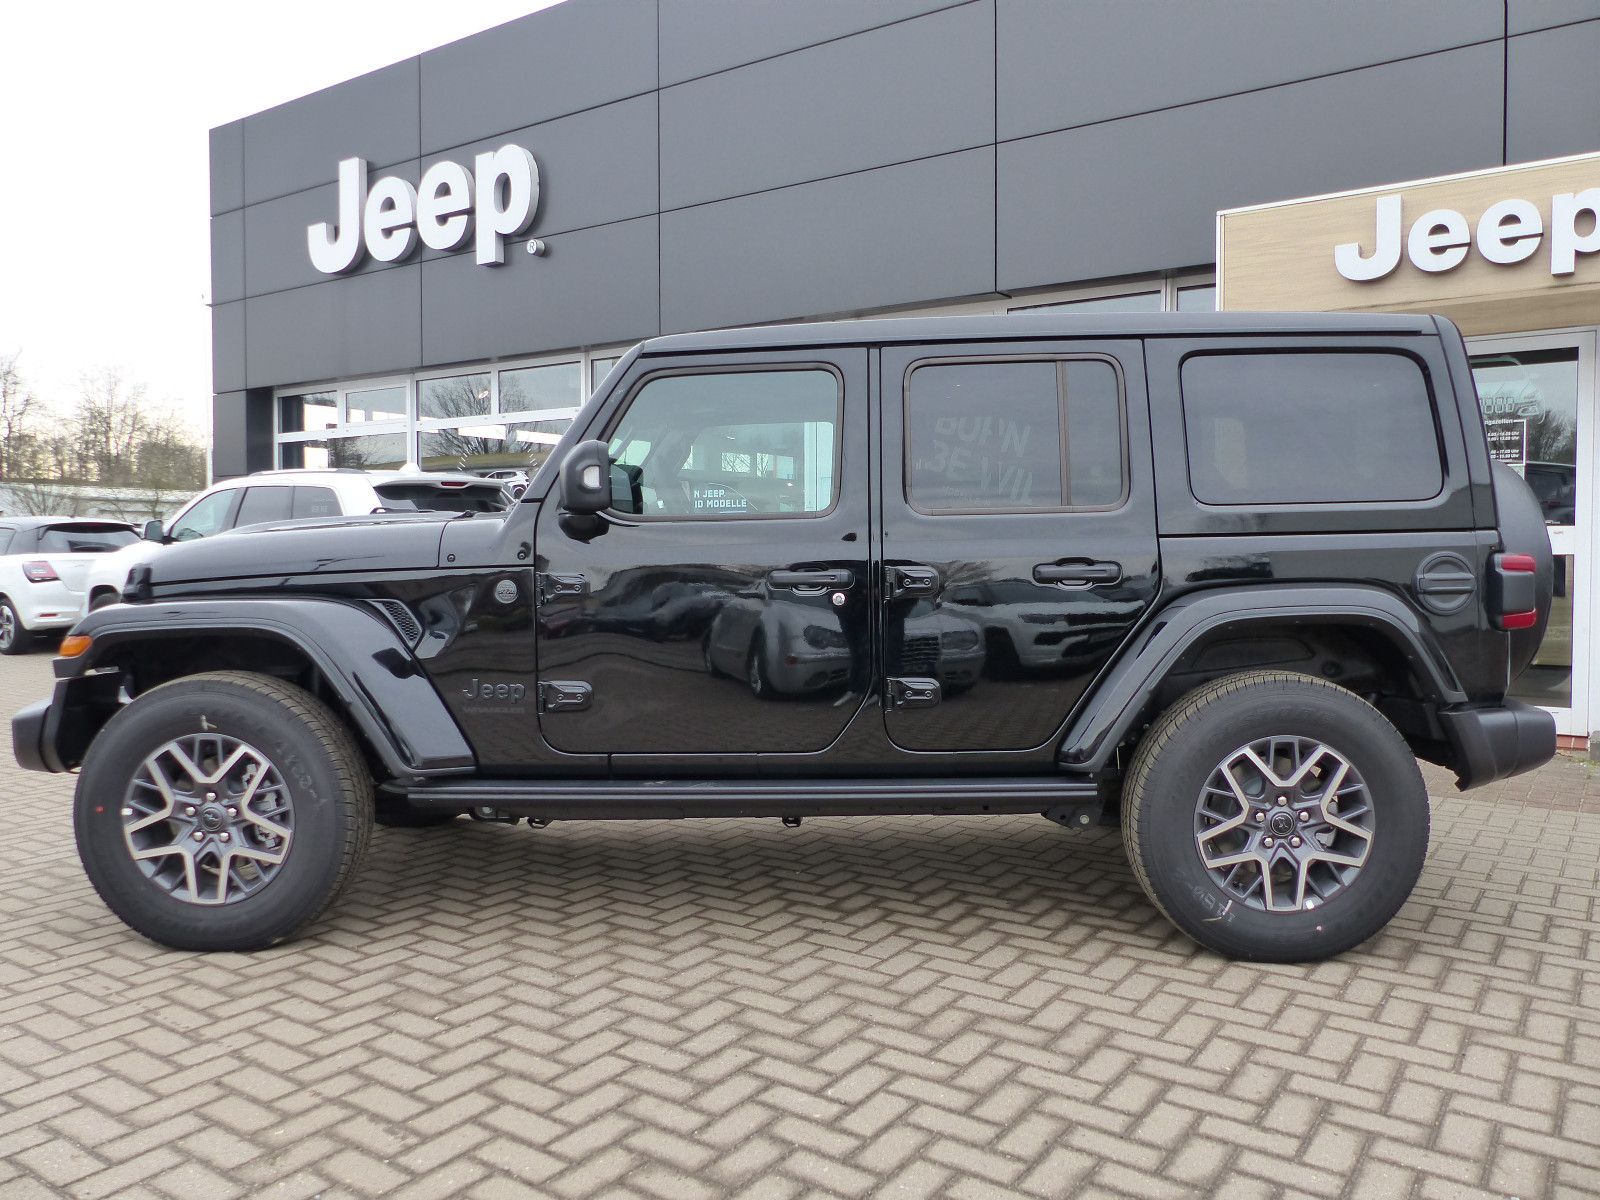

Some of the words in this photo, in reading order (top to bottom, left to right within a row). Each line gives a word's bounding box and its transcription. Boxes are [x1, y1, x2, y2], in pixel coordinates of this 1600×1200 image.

[307, 143, 540, 274] Jeep
[1334, 188, 1600, 281] Jeep
[706, 499, 747, 508] MODELLE
[462, 678, 526, 704] Jeep
